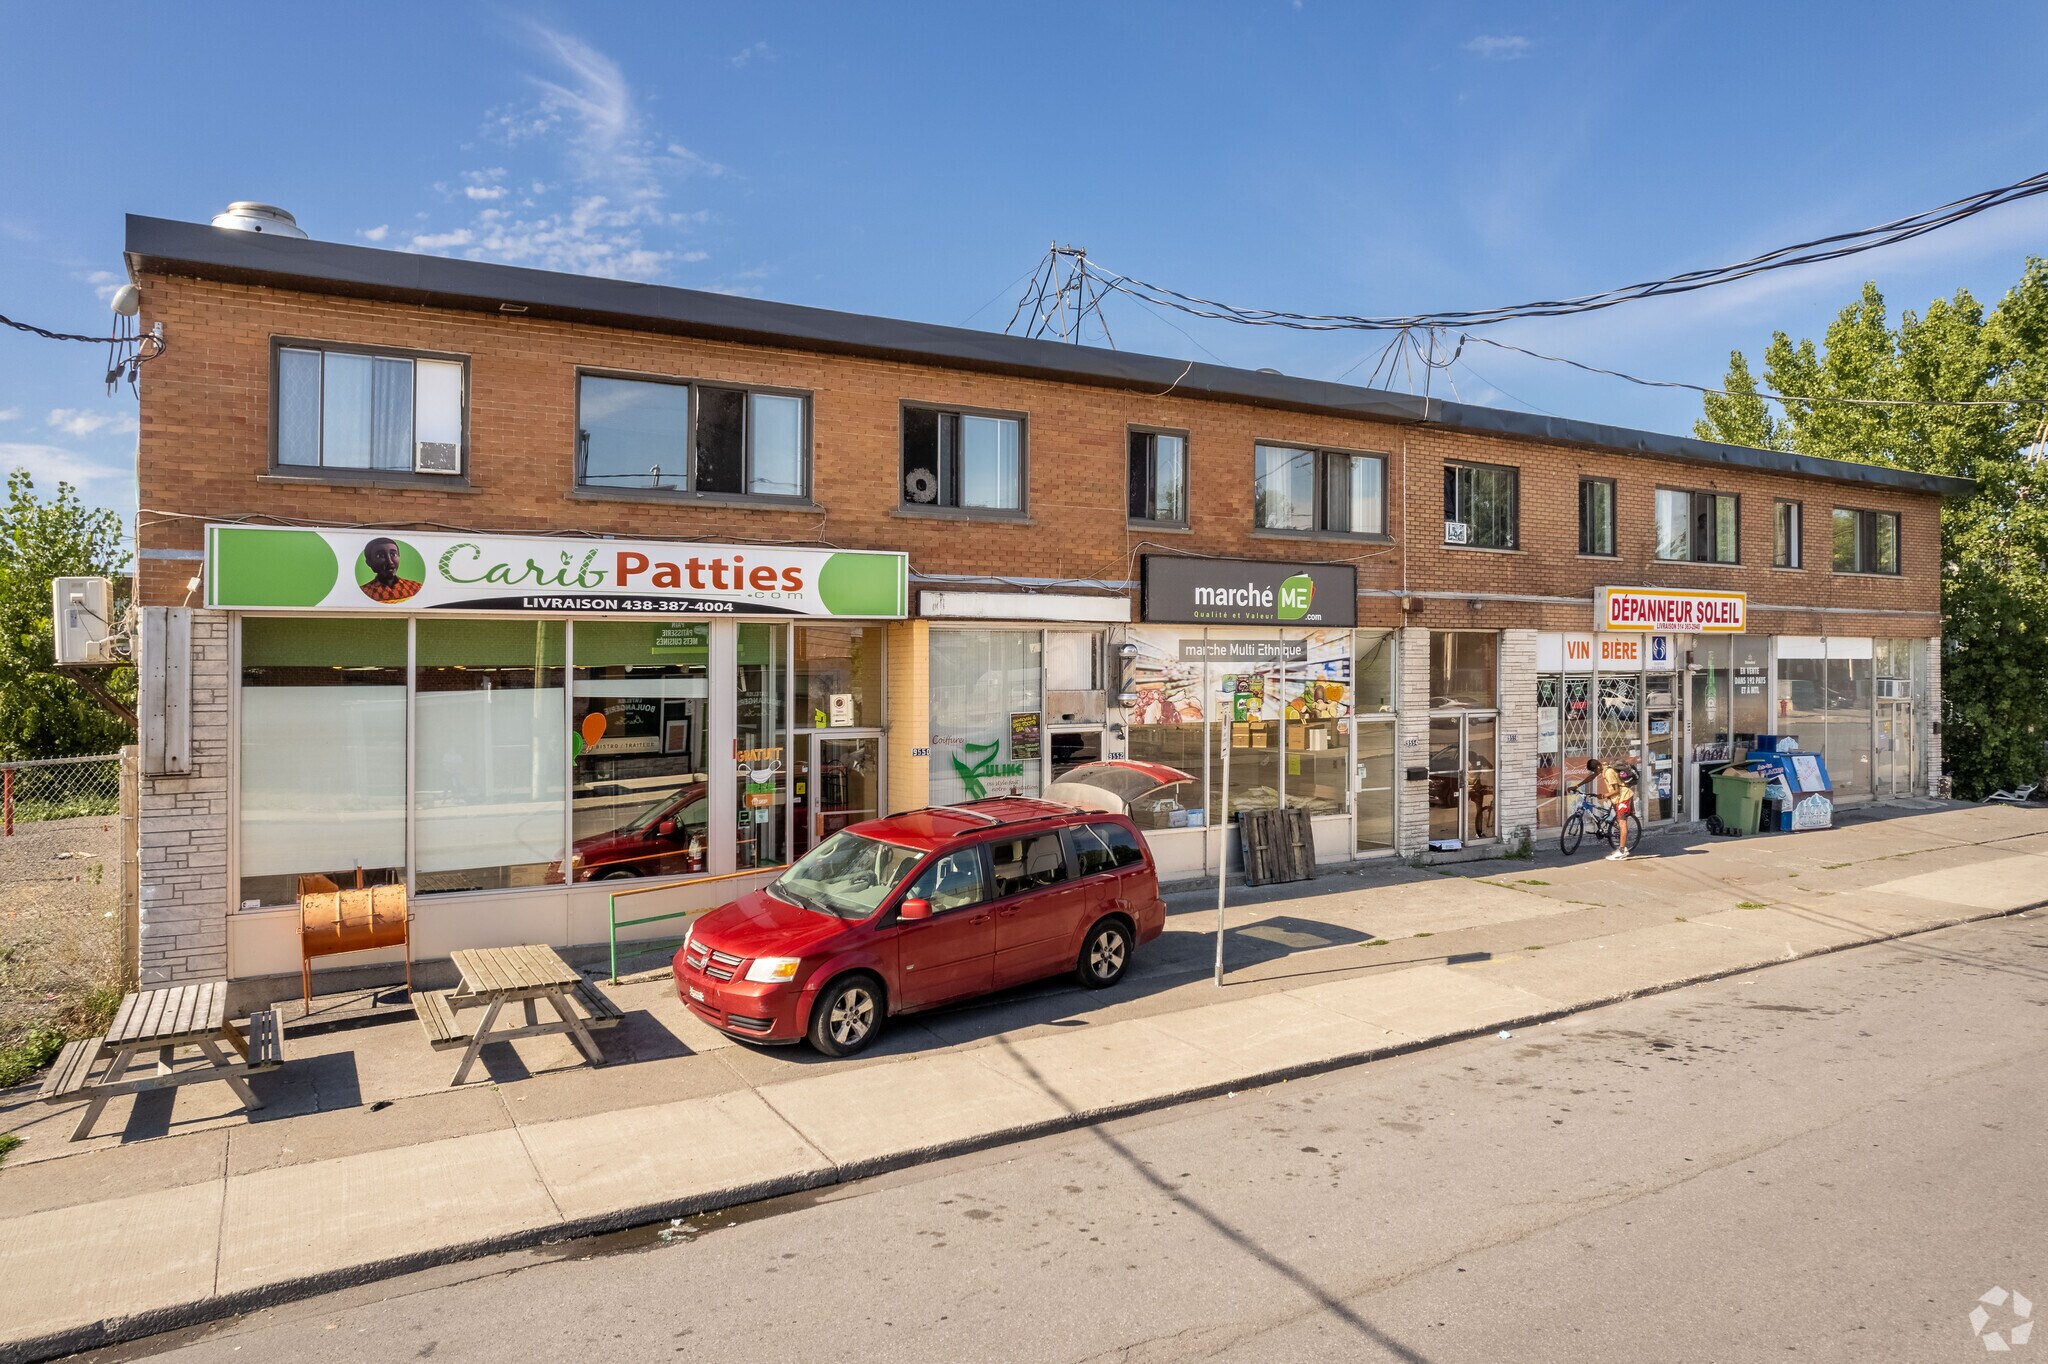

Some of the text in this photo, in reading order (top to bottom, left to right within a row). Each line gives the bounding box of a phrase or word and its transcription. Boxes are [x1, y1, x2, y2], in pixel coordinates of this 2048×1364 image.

[438, 543, 804, 592] Carib Patties
[747, 591, 803, 600] .com
[1194, 582, 1308, 609] marché ME
[523, 597, 734, 612] LIVRAISON 438-387-4004
[1611, 594, 1740, 624] DÉPANNEUR SOLEIL
[1193, 610, 1274, 620] Qualité et Valeur
[1304, 613, 1322, 621] .com
[1656, 622, 1677, 630] LIVRAISON
[1229, 643, 1255, 656] Multi
[1258, 643, 1302, 659] Ethnique
[1567, 638, 1638, 660] VIN BIÈRE
[1746, 667, 1760, 675] VENTE
[932, 735, 965, 745] Coiffure
[737, 747, 783, 763] GRATUIT
